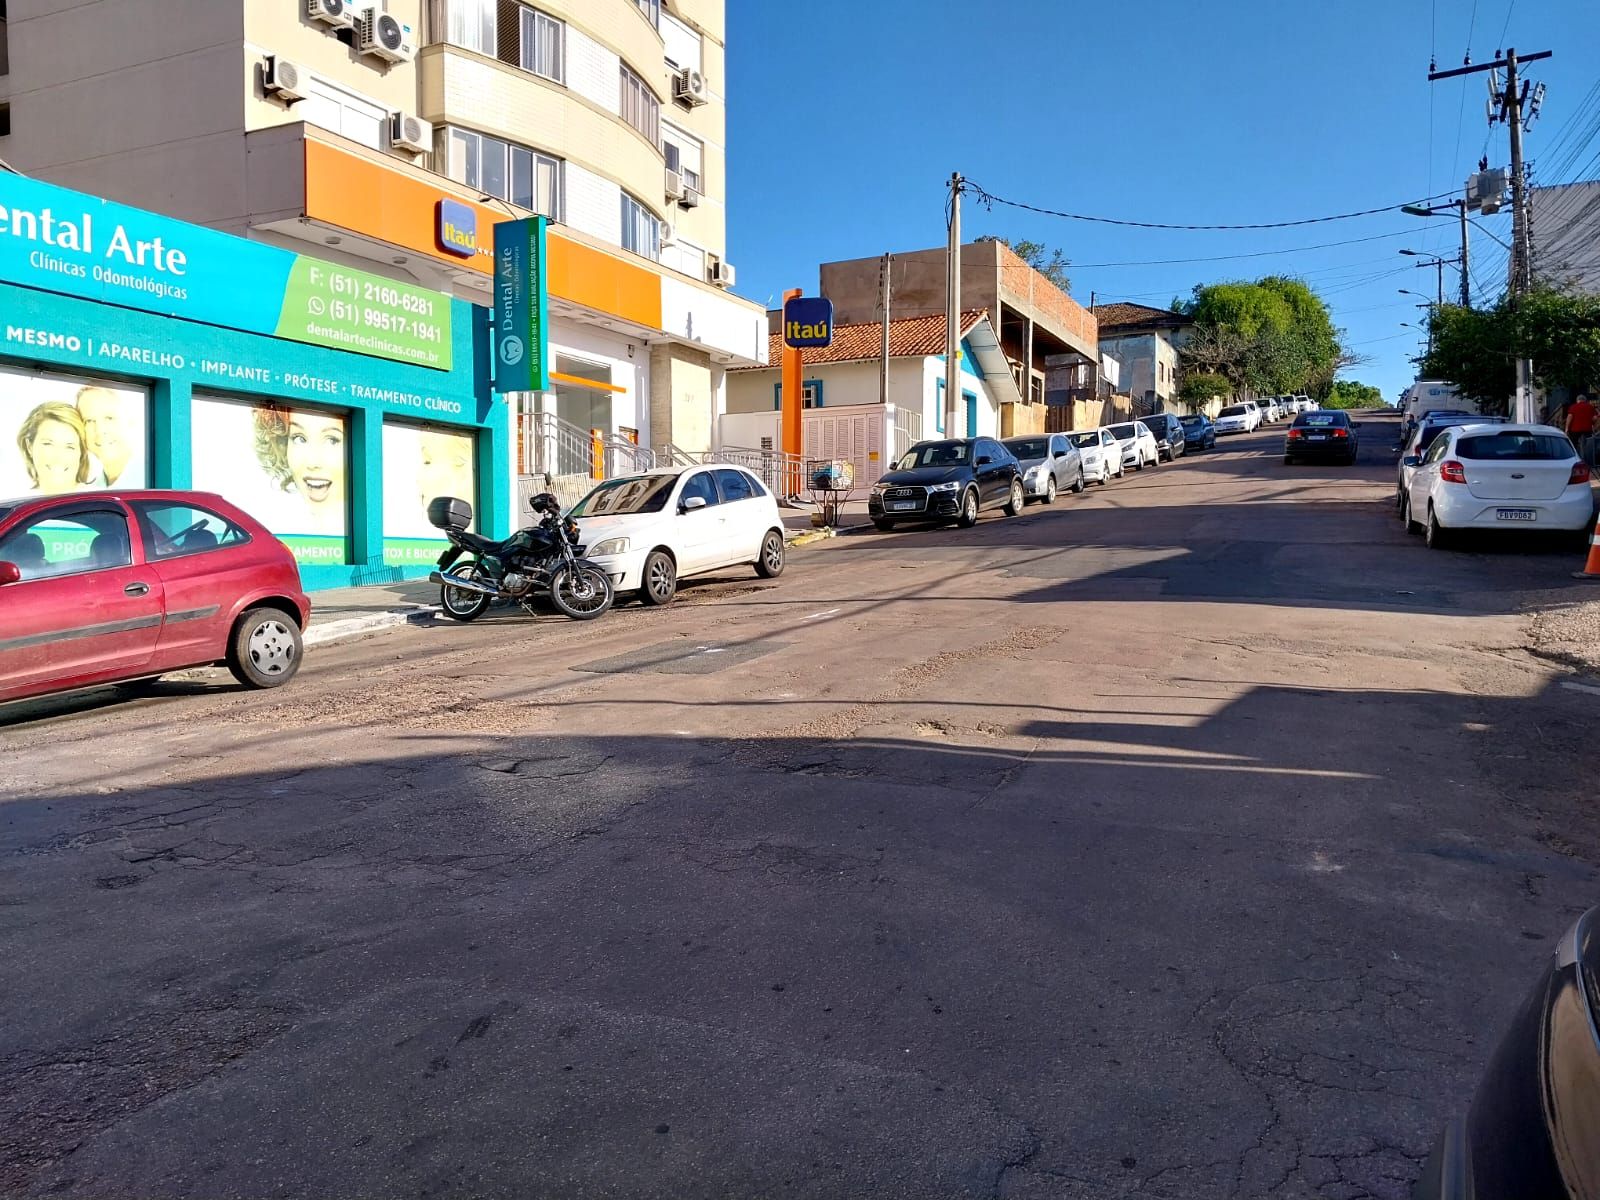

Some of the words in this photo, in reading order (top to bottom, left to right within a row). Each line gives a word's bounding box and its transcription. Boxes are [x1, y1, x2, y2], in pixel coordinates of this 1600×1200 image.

[106, 224, 187, 275] Arte
[444, 223, 475, 249] Itaú
[30, 250, 87, 278] Clínicas
[92, 265, 188, 300] Odontológicas
[502, 247, 514, 278] Arte
[310, 266, 324, 287] F:
[329, 271, 360, 300] (51)
[364, 281, 434, 317] 2160-6281
[502, 282, 514, 331] Dental
[307, 321, 440, 363] dentalarteclinicas.com.br
[329, 298, 360, 327] (51)
[364, 307, 442, 344] 99517-1941
[786, 320, 828, 339] Itaú
[6, 325, 81, 351] MESMO
[98, 341, 185, 369] APARELHO
[201, 358, 271, 384] IMPLANTE
[284, 372, 338, 394] PRÓTESE
[350, 383, 422, 408] TRATAMENTO
[424, 396, 462, 415] CLÍNICO
[52, 539, 90, 556] PRÓ
[383, 547, 404, 559] TOX
[406, 547, 413, 559] E
[414, 547, 442, 560] BICHE
